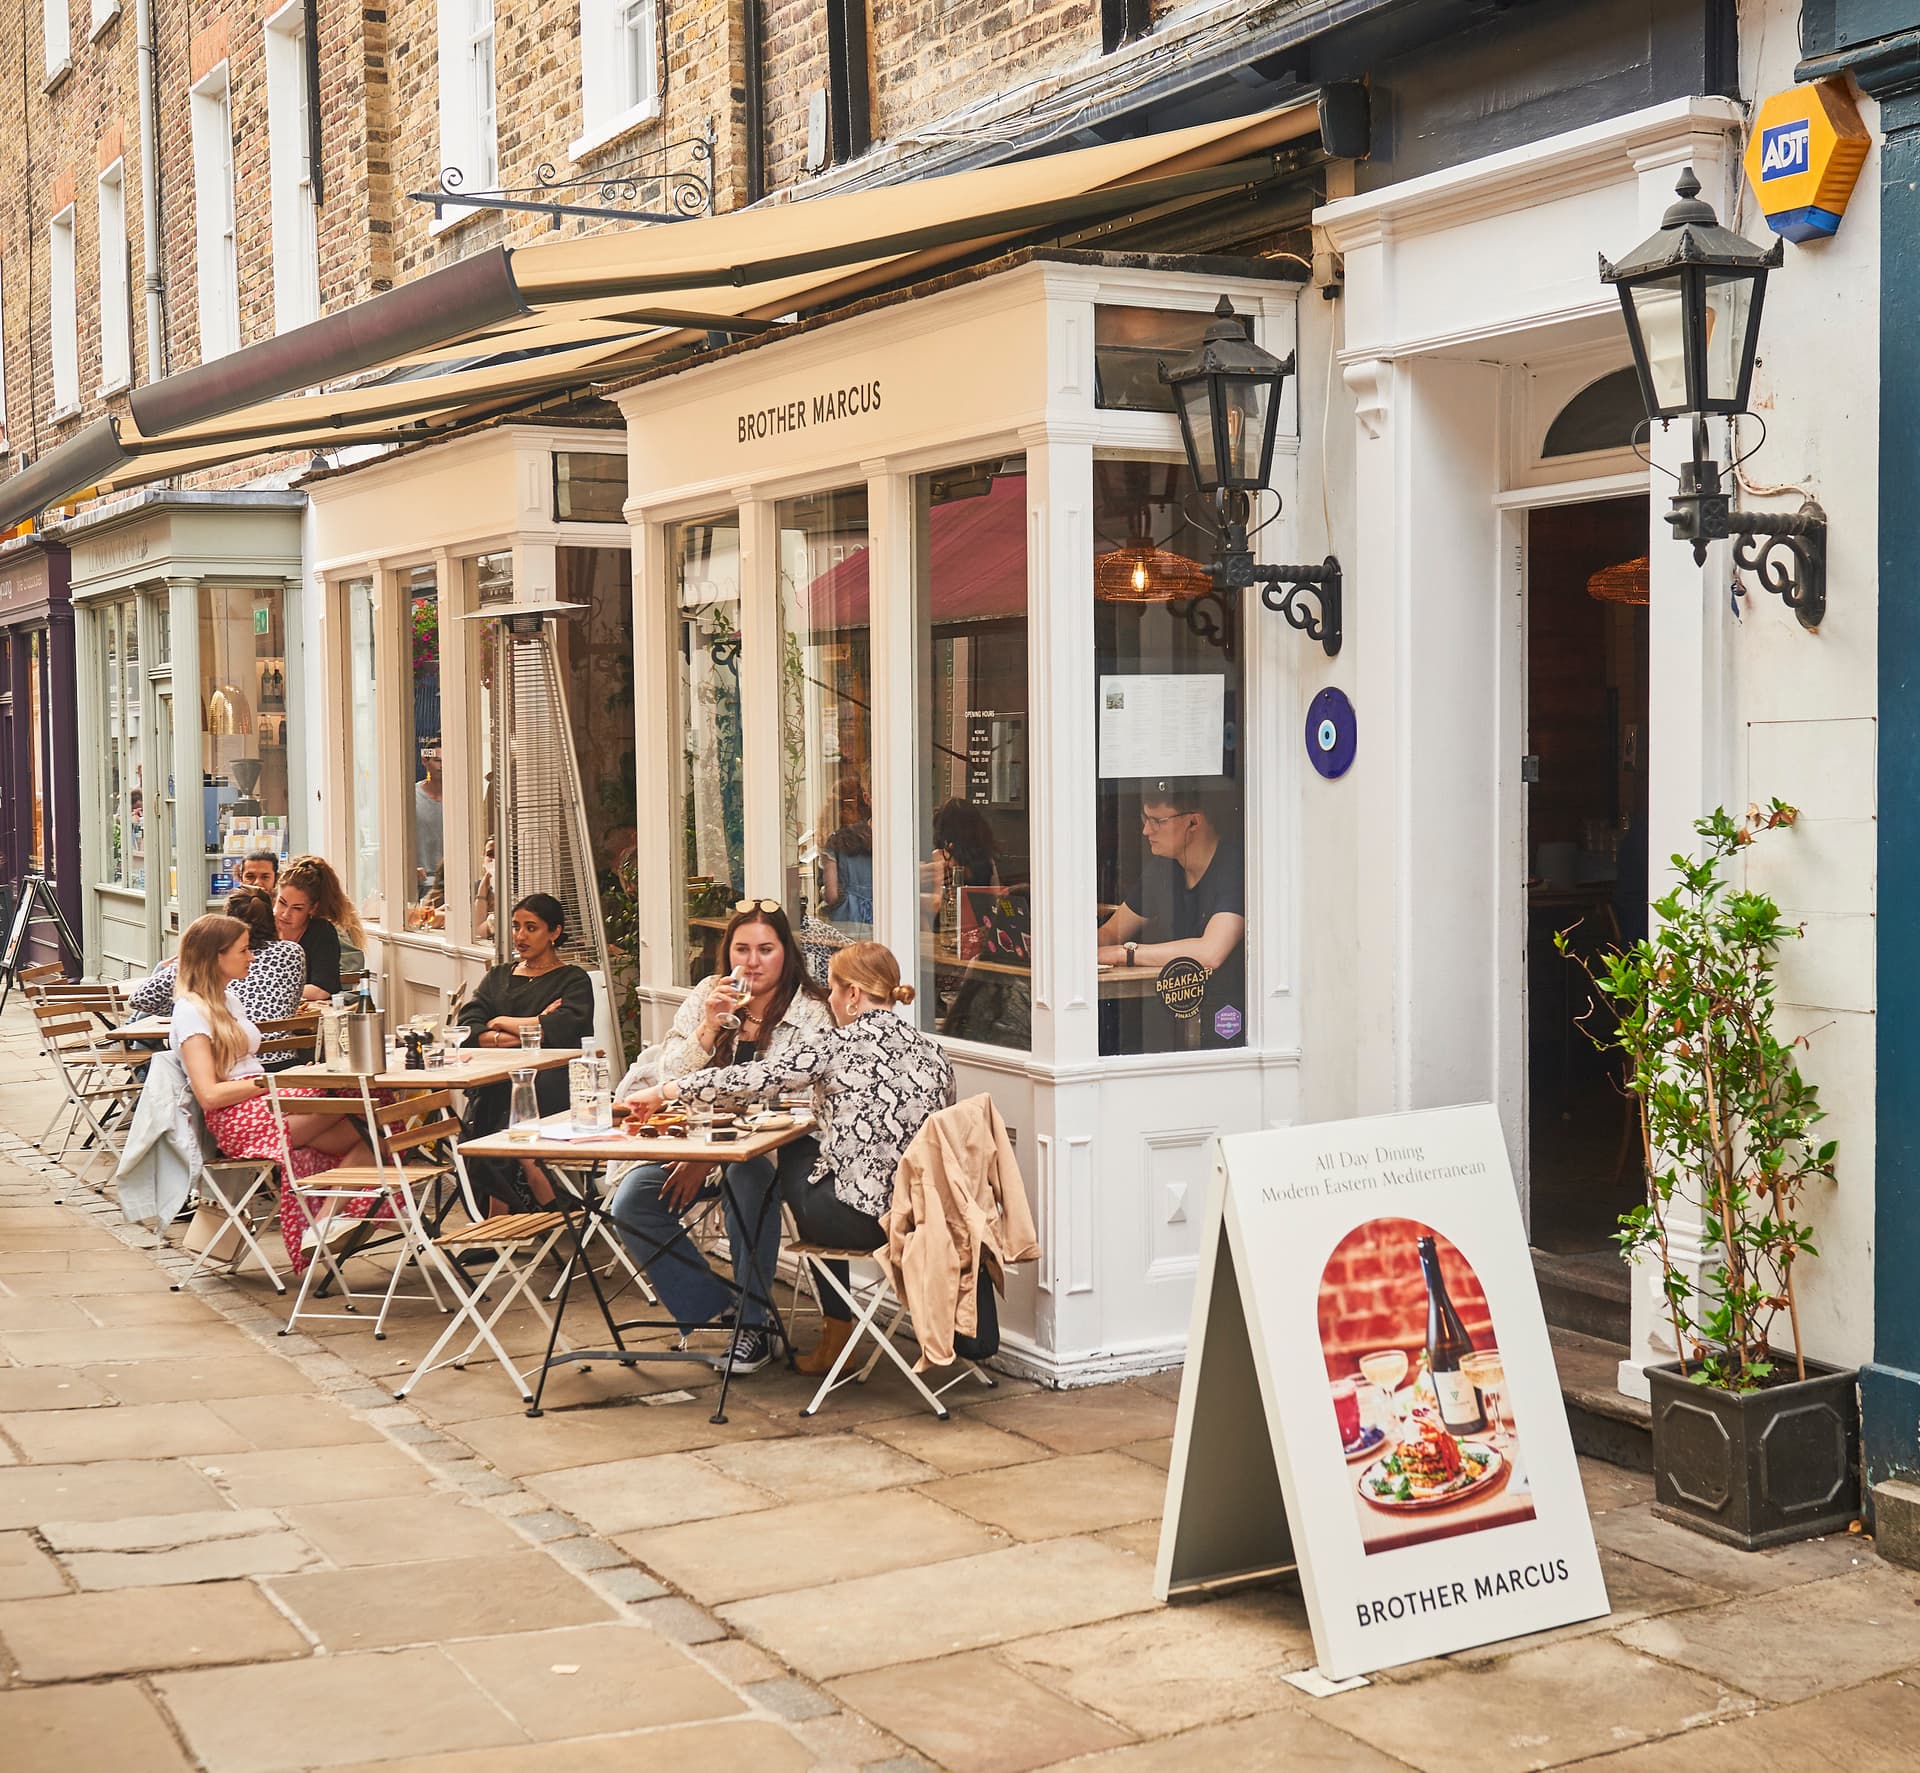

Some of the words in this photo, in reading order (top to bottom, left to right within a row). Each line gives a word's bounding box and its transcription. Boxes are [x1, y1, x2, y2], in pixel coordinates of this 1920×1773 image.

[1762, 128, 1808, 172] ADT
[738, 400, 807, 443] BROTHER
[813, 380, 881, 425] MARCUS
[964, 710, 982, 719] OPENING
[982, 710, 995, 718] HOURS
[1156, 968, 1210, 992] BREAKFAST
[1165, 985, 1204, 1004] BRUNCH
[1175, 1007, 1200, 1019] FINALIST
[1316, 1153, 1335, 1172] All
[1339, 1150, 1369, 1170] Day
[1374, 1145, 1425, 1164] Dining
[1261, 1182, 1320, 1204] Modern
[1324, 1174, 1377, 1195] Eastern
[1382, 1159, 1487, 1187] Mediterranean
[1356, 1582, 1468, 1627] BROTHER
[1474, 1559, 1569, 1600] MARCUS
